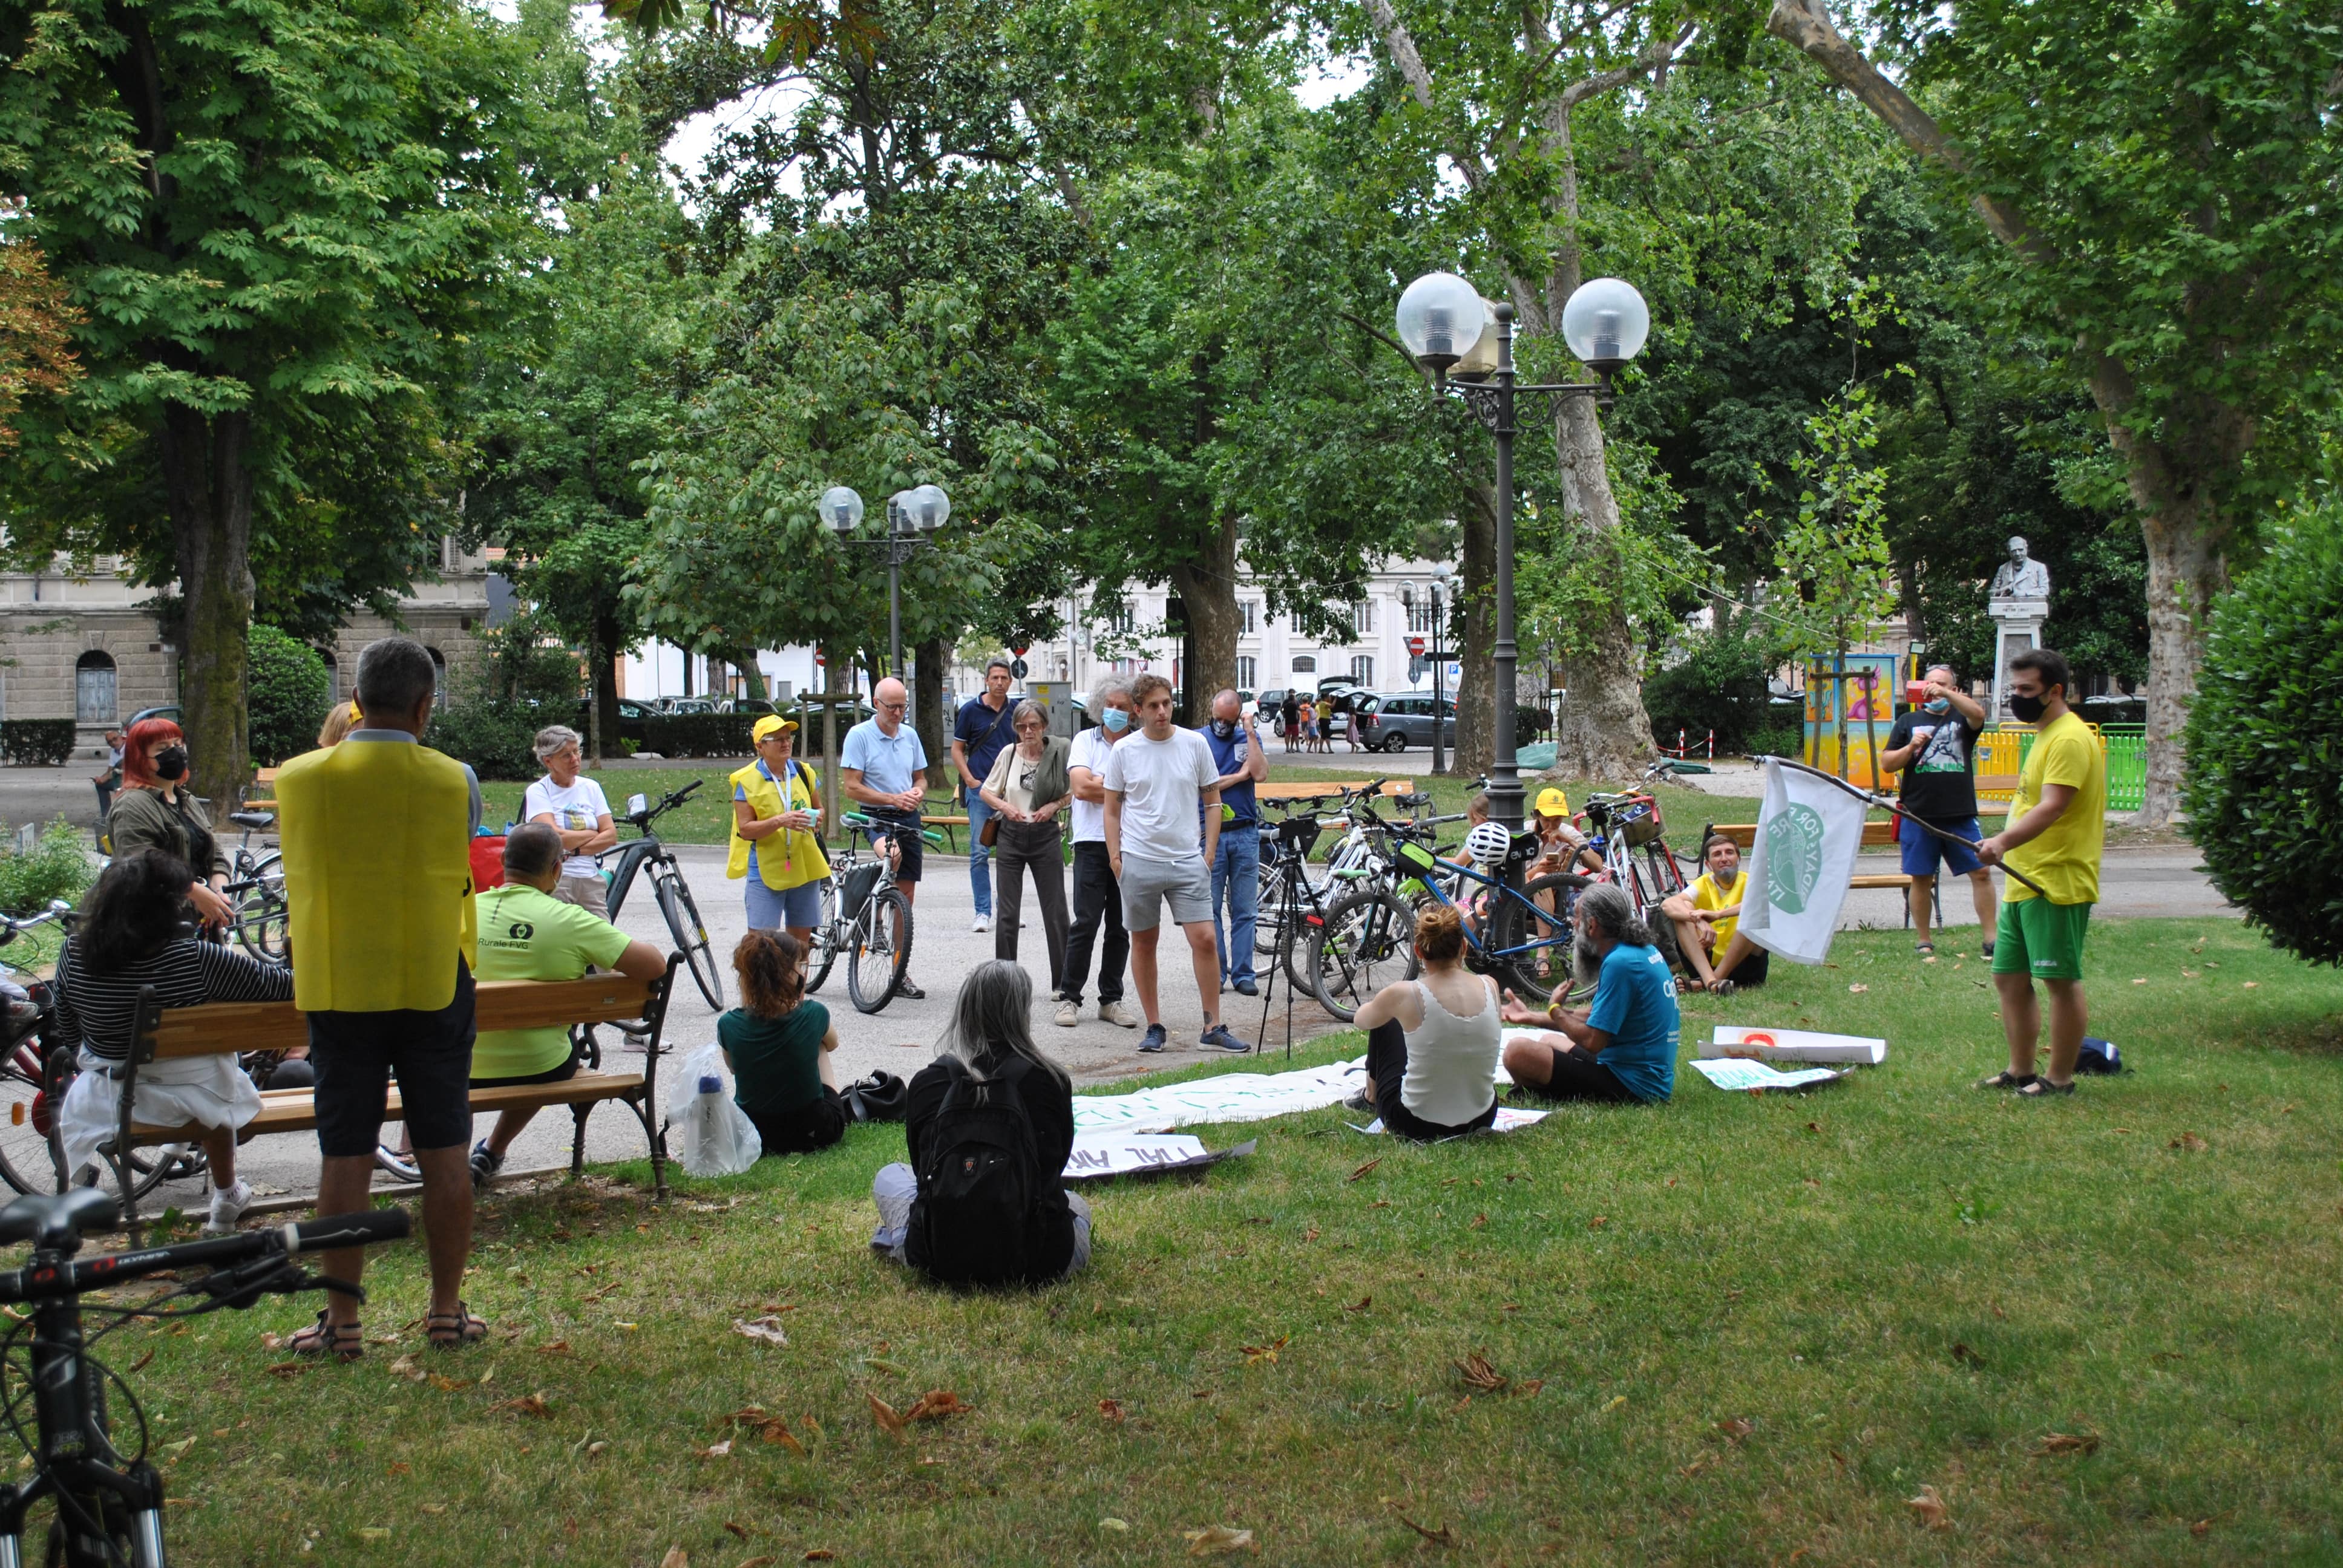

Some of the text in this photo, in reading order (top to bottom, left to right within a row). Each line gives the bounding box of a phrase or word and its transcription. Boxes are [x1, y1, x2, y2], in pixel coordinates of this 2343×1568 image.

[1915, 762, 1965, 774] CALLING
[479, 938, 528, 949] Rurale FVG
